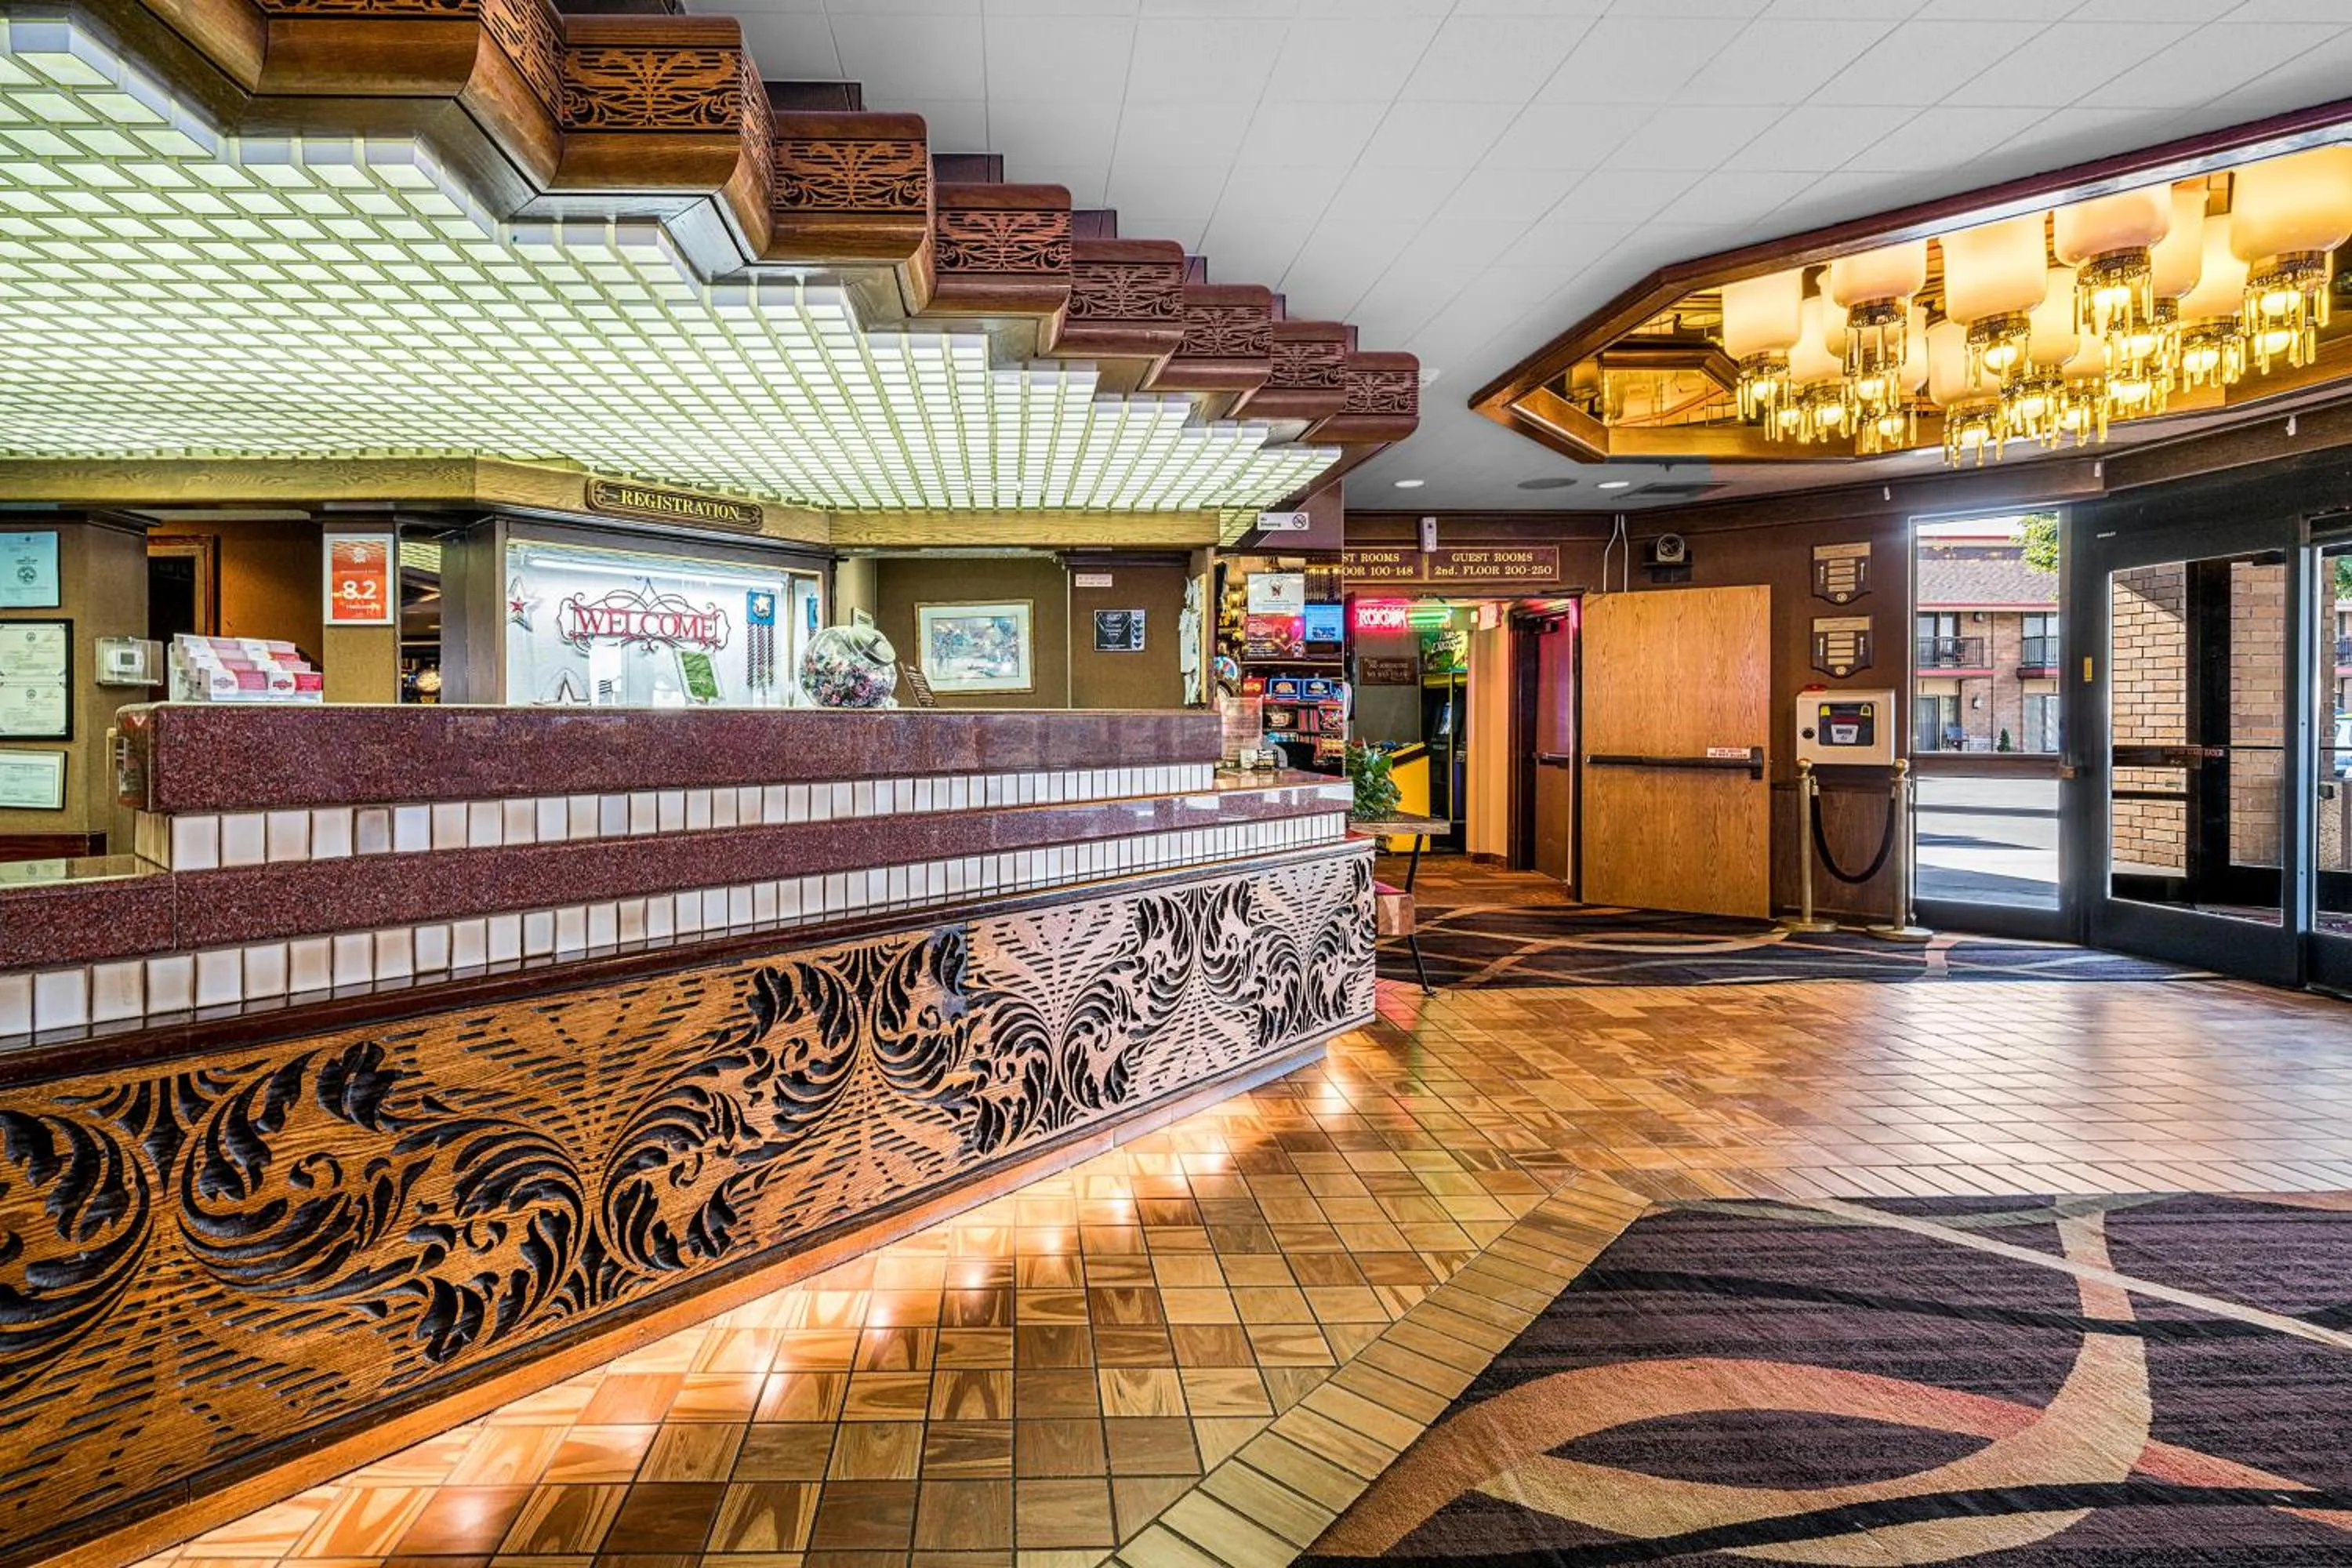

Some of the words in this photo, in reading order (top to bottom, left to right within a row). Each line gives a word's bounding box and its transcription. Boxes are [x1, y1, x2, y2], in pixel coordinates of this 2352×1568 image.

[620, 490, 739, 520] REGISTRATION
[1361, 554, 1399, 563] ROOMS
[1452, 553, 1489, 563] GUEST
[1494, 553, 1533, 562] ROOMS
[1371, 567, 1414, 576] 100-148
[1435, 566, 1457, 575] 2nd.
[1464, 566, 1500, 575] FLOOR
[1504, 566, 1552, 575] 200-250
[343, 580, 376, 600] 8.2
[574, 606, 717, 640] WELCOME
